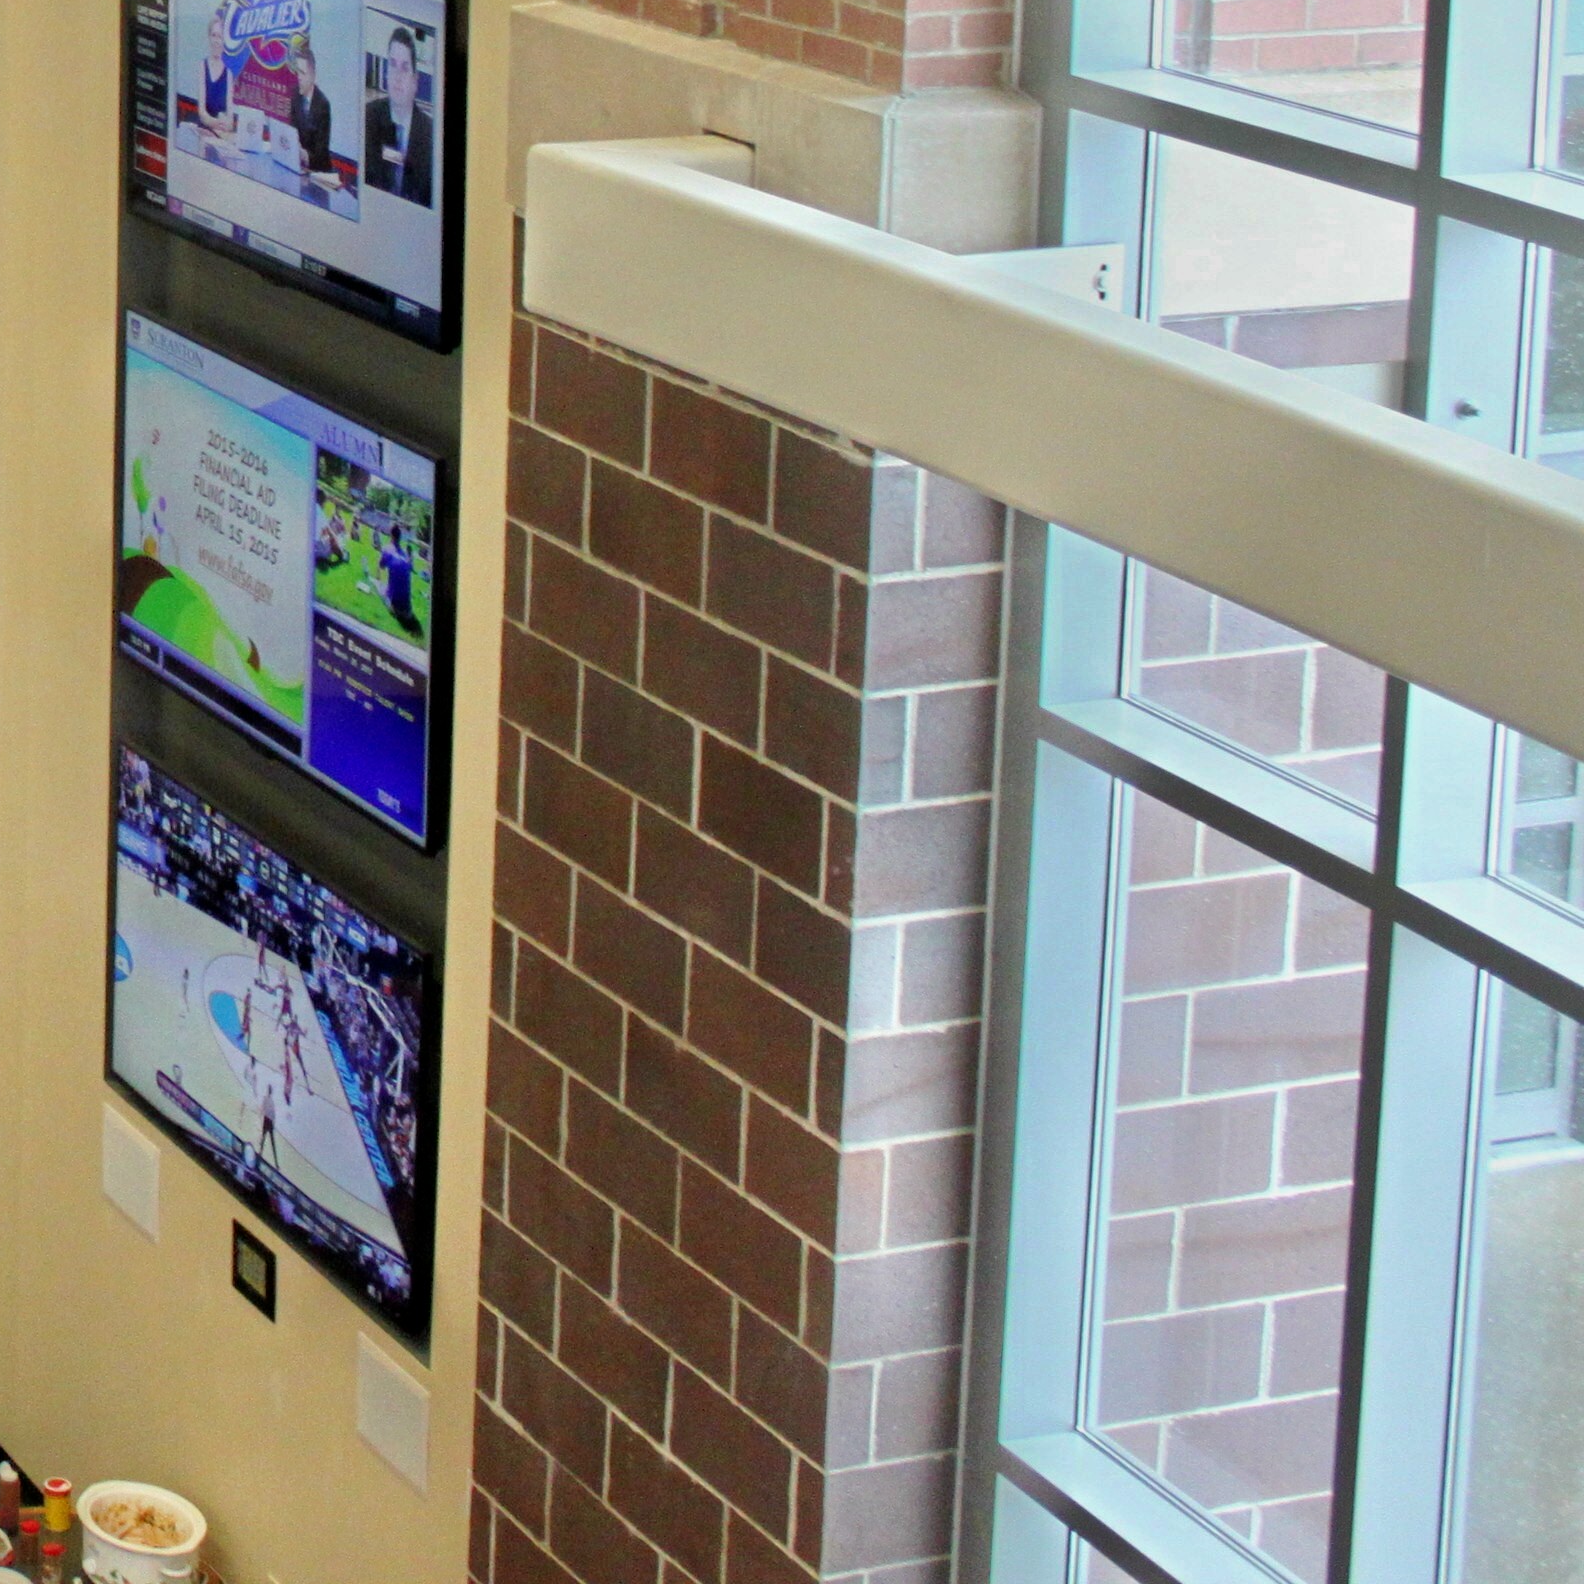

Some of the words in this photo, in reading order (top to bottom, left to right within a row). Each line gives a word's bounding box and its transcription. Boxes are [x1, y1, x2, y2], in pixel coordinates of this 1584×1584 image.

[242, 71, 287, 93] CLEVELAND
[200, 451, 253, 496] FINANCIAL
[257, 484, 276, 507] AID
[207, 429, 268, 476] 2015-2016
[193, 474, 225, 508] FILING
[229, 494, 281, 540] DEADLINE
[196, 504, 224, 535] APRIL
[229, 524, 246, 550] 15,
[249, 536, 279, 565] 2015
